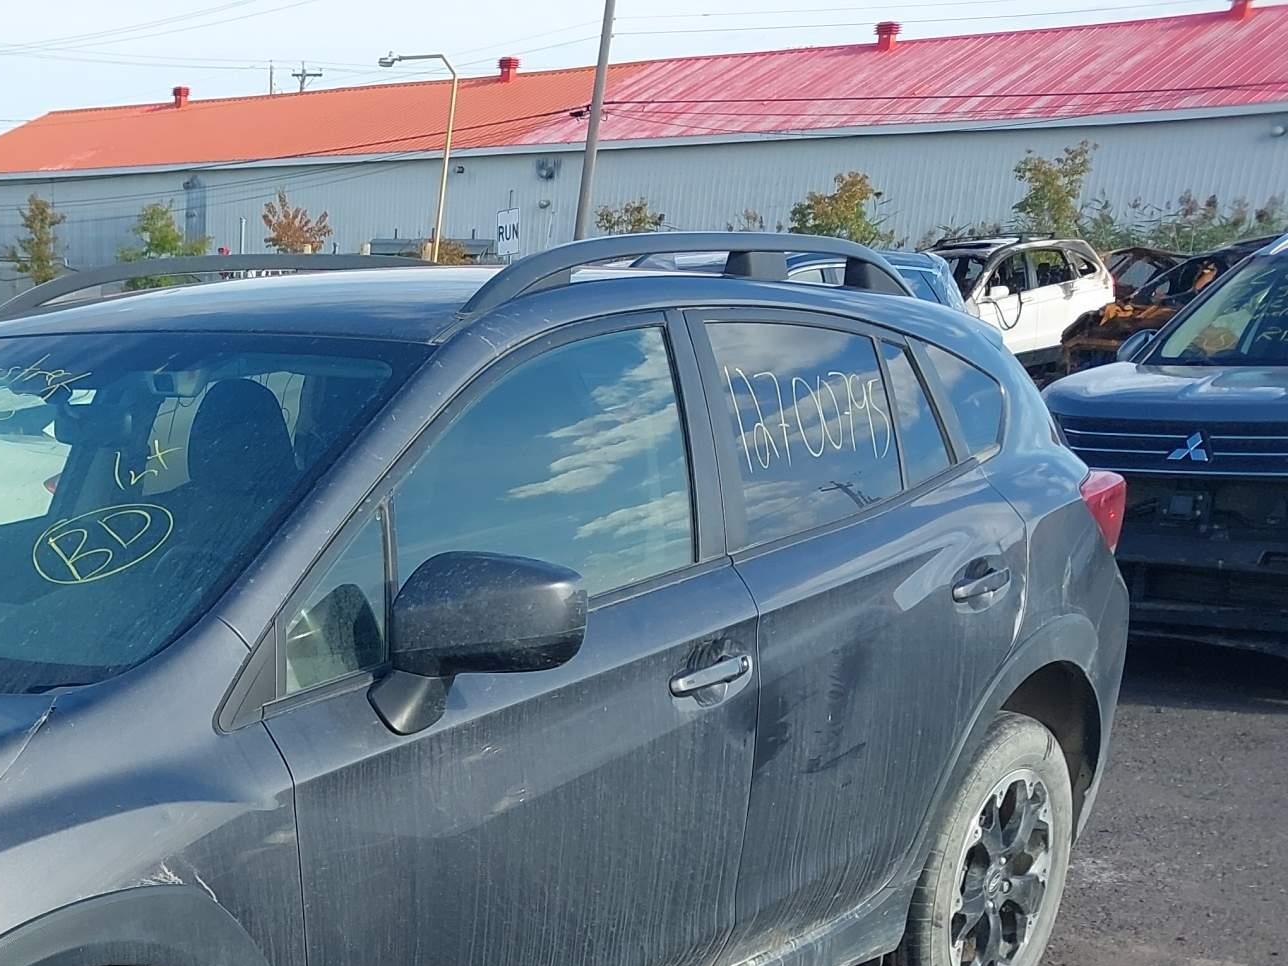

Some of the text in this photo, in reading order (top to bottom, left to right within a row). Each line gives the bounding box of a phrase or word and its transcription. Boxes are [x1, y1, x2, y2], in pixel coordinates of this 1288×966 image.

[498, 223, 519, 242] RUN
[724, 366, 890, 474] 12700795
[48, 509, 151, 582] BD
